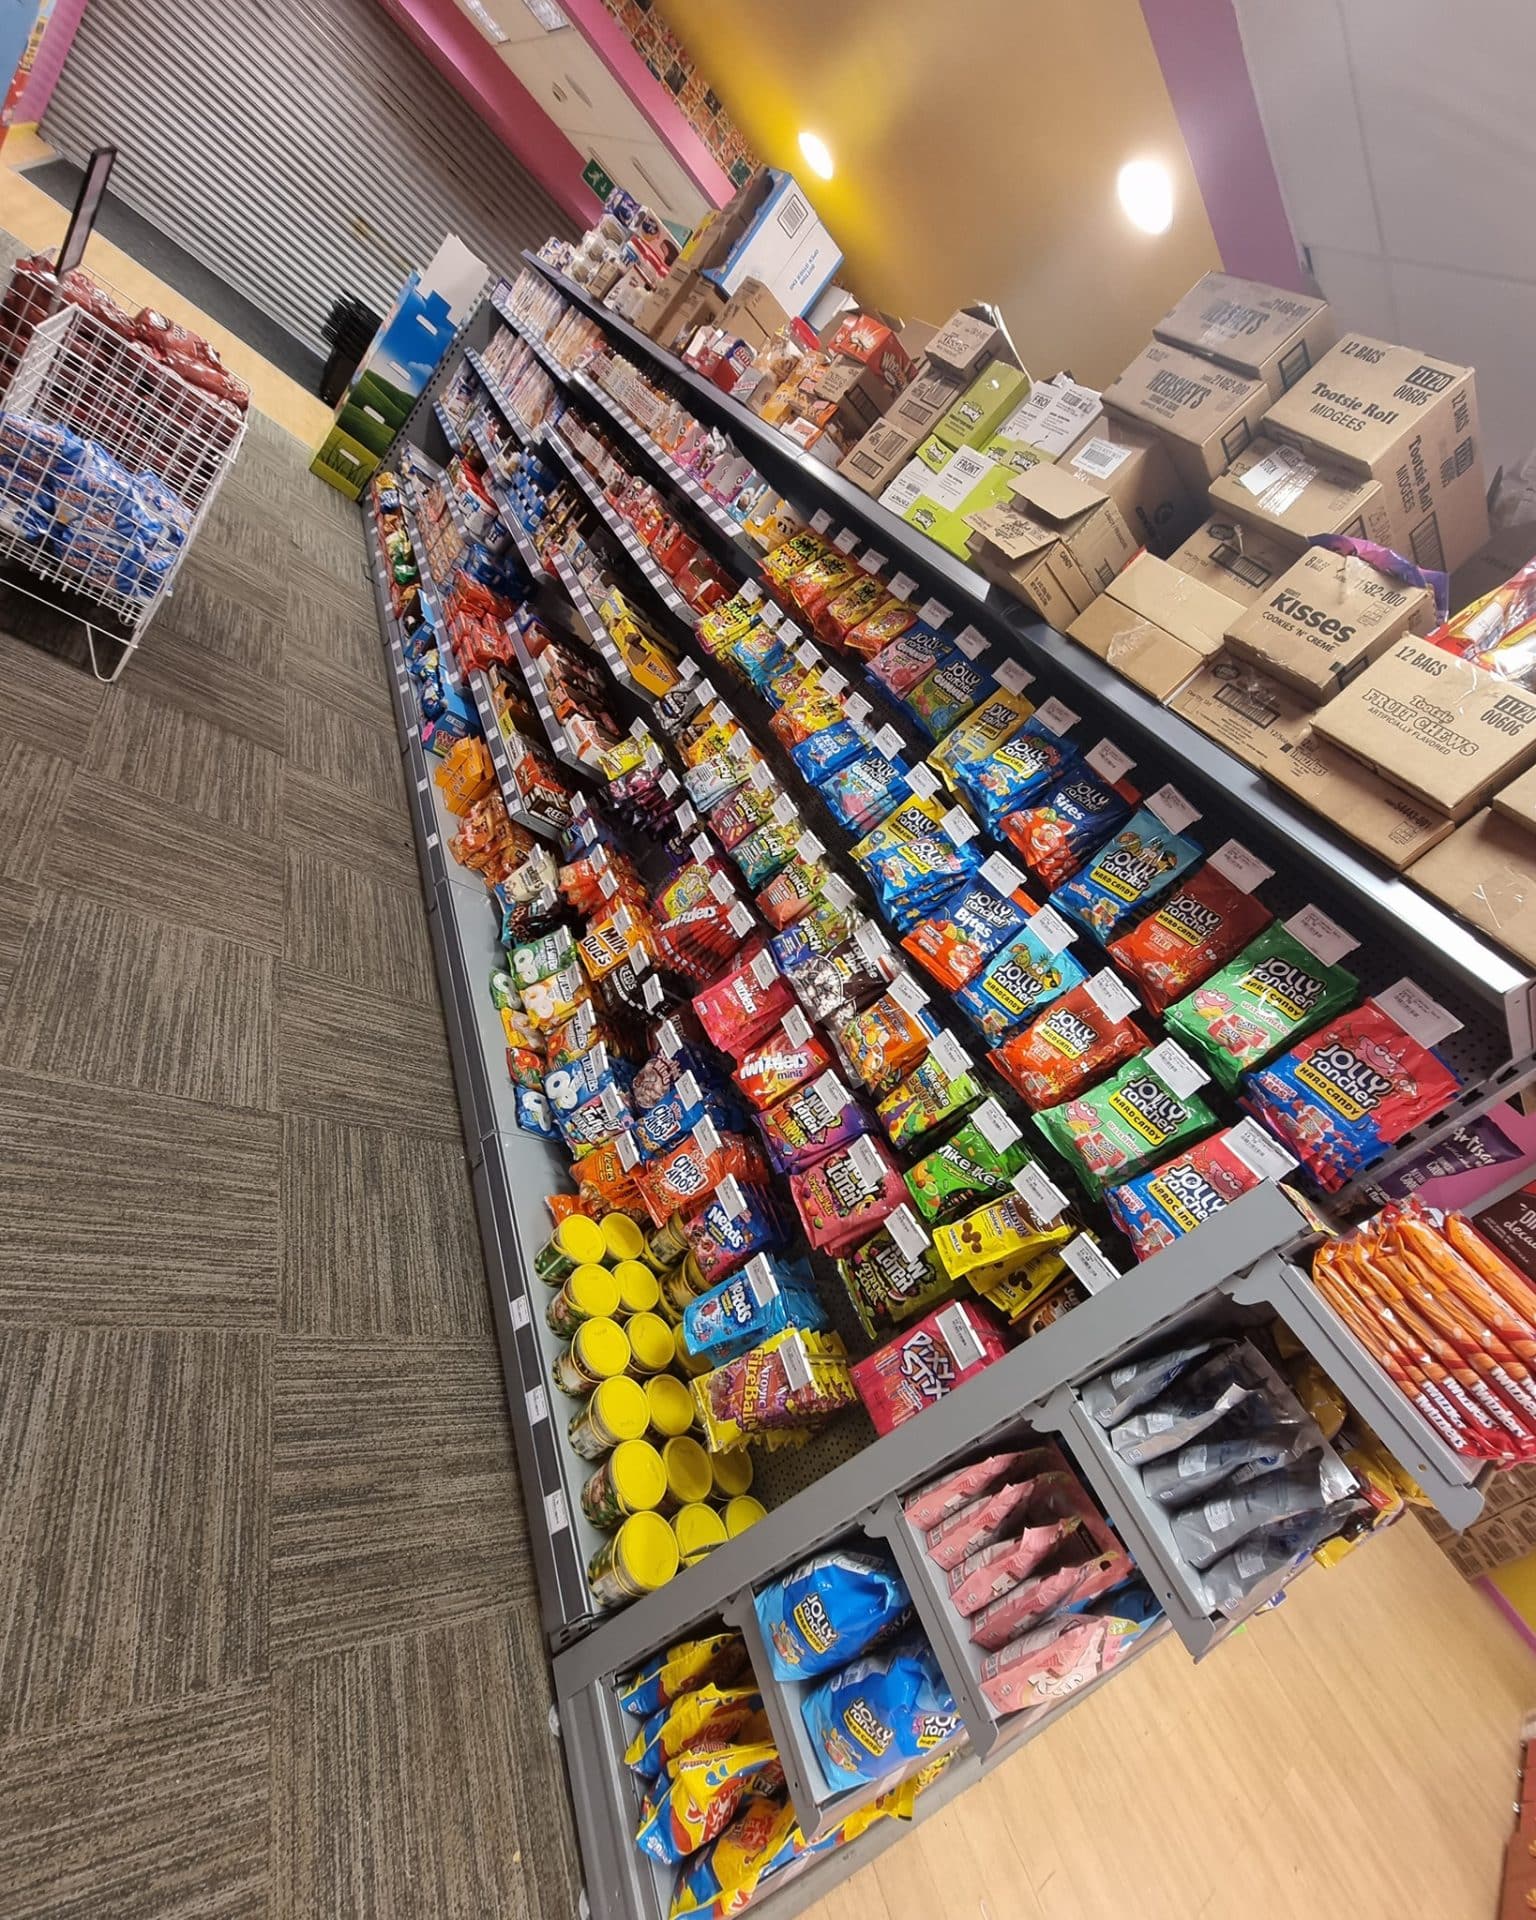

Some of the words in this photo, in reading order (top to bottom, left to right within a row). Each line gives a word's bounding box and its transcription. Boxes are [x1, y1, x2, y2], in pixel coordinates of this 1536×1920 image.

[1341, 341, 1360, 355] 12
[1354, 345, 1385, 364] BAGS
[1146, 370, 1212, 409] HERSHEY'S
[1393, 384, 1432, 406] 00605
[1410, 368, 1450, 390] 71720
[1310, 402, 1366, 432] MIDGEES
[1312, 382, 1363, 410] Tootsie
[1363, 403, 1399, 424] Roll
[957, 458, 980, 475] FRONT
[1408, 435, 1427, 486] Tootsie
[1396, 464, 1416, 514] MIDGEES
[1416, 482, 1433, 512] Roll
[910, 632, 944, 651] JOLLY
[1262, 611, 1295, 632] COOKIES
[1307, 634, 1336, 653] CREME
[947, 661, 981, 687] JOLLY
[1395, 645, 1412, 661] 12
[1411, 651, 1448, 677] BAGS
[1362, 688, 1414, 723] FRUIT
[1413, 715, 1479, 756] CHEWS
[1410, 695, 1455, 723] Tootsie
[1480, 709, 1524, 736] 00606
[1367, 707, 1412, 738] ARTIFICIALLY
[1411, 730, 1451, 756] FLAVORED
[866, 757, 897, 779] JOLLY
[1007, 738, 1049, 767] JOLLY
[733, 794, 757, 823] PUNCH
[1055, 792, 1086, 821] Bites
[1062, 786, 1101, 813] rancher
[1070, 781, 1109, 811] JOLLY
[902, 807, 937, 832] JOLLY
[782, 864, 810, 898] PUNCH
[1101, 859, 1149, 891] rancher
[1106, 850, 1157, 881] JOLLY
[1094, 870, 1112, 884] HARD
[1111, 880, 1136, 898] CANDY
[965, 899, 1007, 928] rancher
[970, 891, 1013, 918] JOLLY
[1164, 903, 1212, 938] rancher
[1170, 895, 1220, 927] JOLLY
[600, 925, 629, 955] Milk
[798, 917, 823, 951] PUNCH
[955, 907, 994, 939] Bites
[1158, 912, 1179, 929] HARD
[1177, 925, 1202, 945] CANDY
[582, 938, 611, 967] Duds
[993, 971, 1035, 1007] rancher
[999, 961, 1043, 995] JOLLY
[1252, 968, 1318, 1010] rancher
[1258, 957, 1327, 993] JOLLY
[986, 978, 1006, 997] HARD
[1001, 992, 1024, 1013] CANDY
[1046, 1018, 1090, 1055] rancher
[1050, 1009, 1098, 1043] JOLLY
[740, 1049, 809, 1080] Twizzlers
[776, 1068, 804, 1080] minis
[1319, 1043, 1397, 1094] JOLLY
[922, 1062, 940, 1089] Mike
[935, 1090, 949, 1106] Ike
[1299, 1066, 1330, 1090] HARD
[1324, 1087, 1364, 1118] CANDY
[1310, 1056, 1382, 1110] rancher
[653, 1103, 674, 1130] Chips
[792, 1100, 818, 1135] LATER
[1121, 1086, 1178, 1137] rancher
[1127, 1076, 1188, 1125] JOLLY
[645, 1115, 680, 1142] Ahoy!
[1112, 1094, 1136, 1118] HARD
[1131, 1114, 1162, 1142] CANDY
[671, 1154, 702, 1185] Chips
[937, 1144, 971, 1171] Mike
[665, 1169, 709, 1196] Ahoy!
[824, 1160, 863, 1208] LATER
[1152, 1182, 1172, 1206] HARD
[1170, 1165, 1229, 1212] JOLLY
[707, 1205, 744, 1249] Nerds
[989, 1209, 1002, 1235] Rollers
[875, 1251, 914, 1295] LATER
[727, 1279, 752, 1322] Nerds
[902, 1329, 955, 1381] PIXY
[756, 1365, 770, 1409] ATOMIC
[900, 1350, 949, 1399] STIX
[1443, 1376, 1493, 1429] Twizzlers
[1471, 1380, 1526, 1438] Twizzlers
[1416, 1392, 1468, 1448] Twizzlers
[802, 1598, 832, 1648] rancher
[806, 1592, 838, 1642] JOLLY
[853, 1698, 895, 1742] JOLLY
